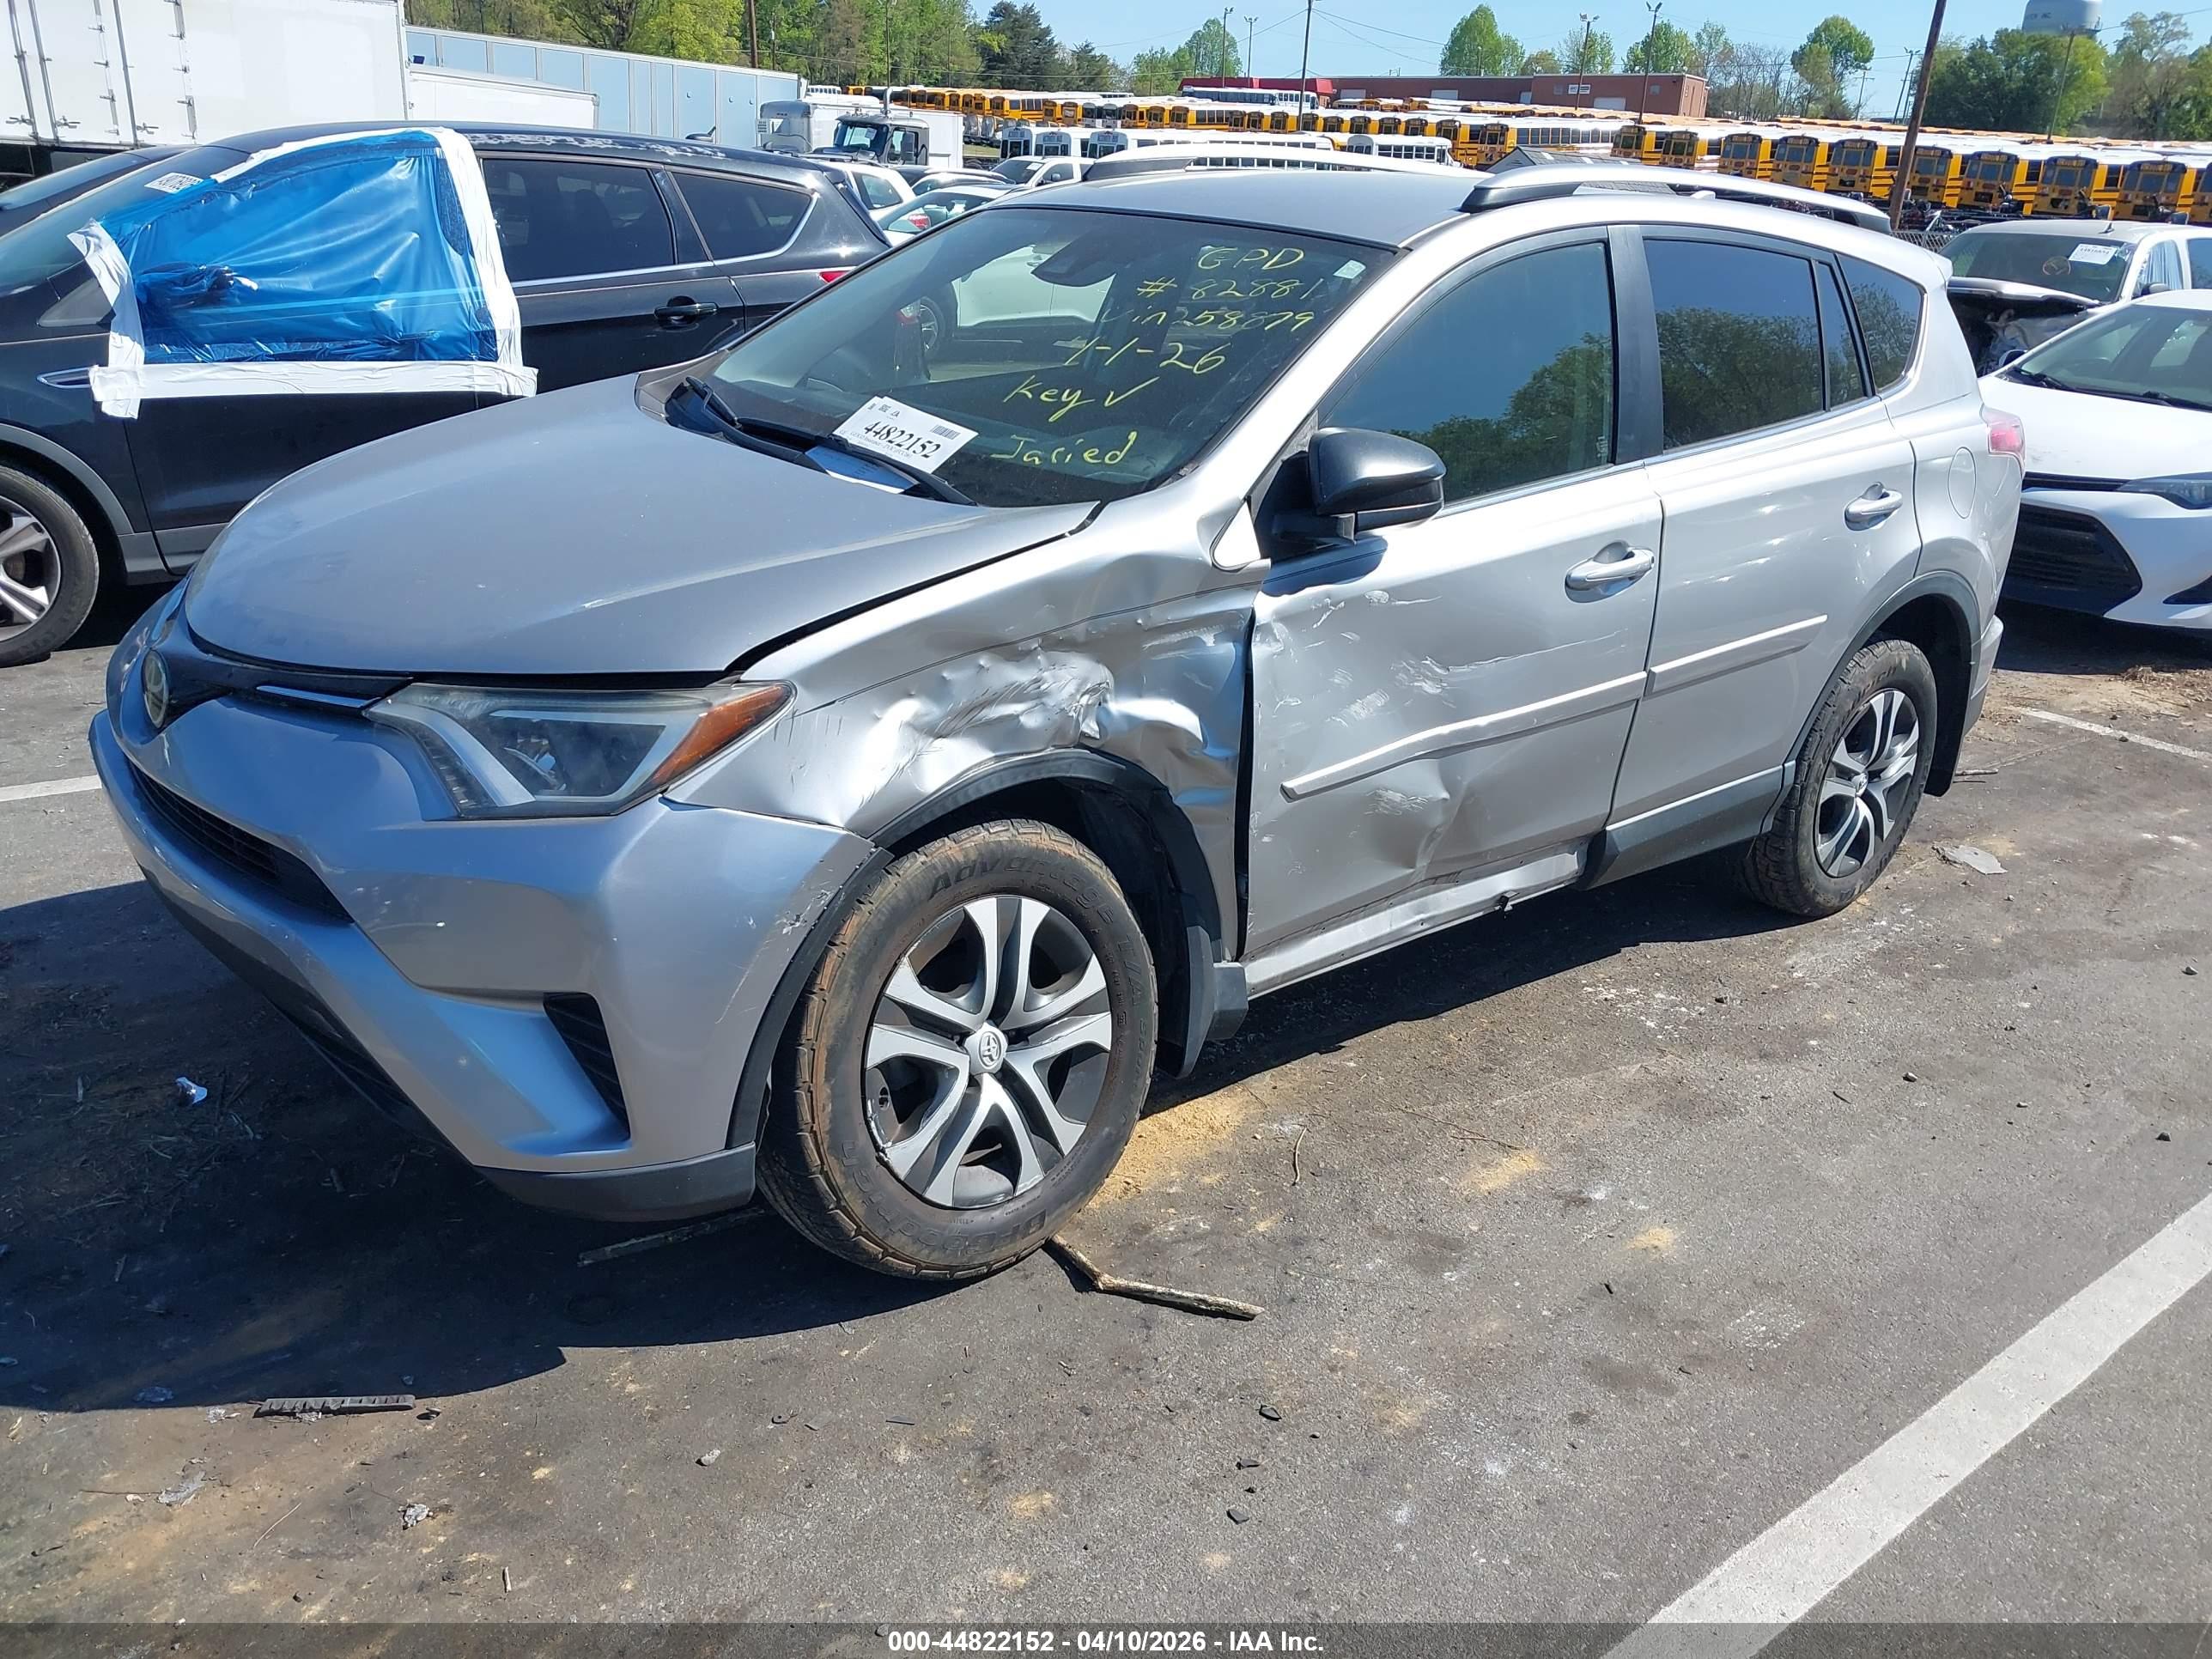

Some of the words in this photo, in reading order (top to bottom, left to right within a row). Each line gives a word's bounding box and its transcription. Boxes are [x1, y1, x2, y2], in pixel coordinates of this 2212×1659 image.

[1137, 276, 1177, 298] #
[1192, 278, 1324, 300] 82881
[864, 421, 942, 459] 44822152
